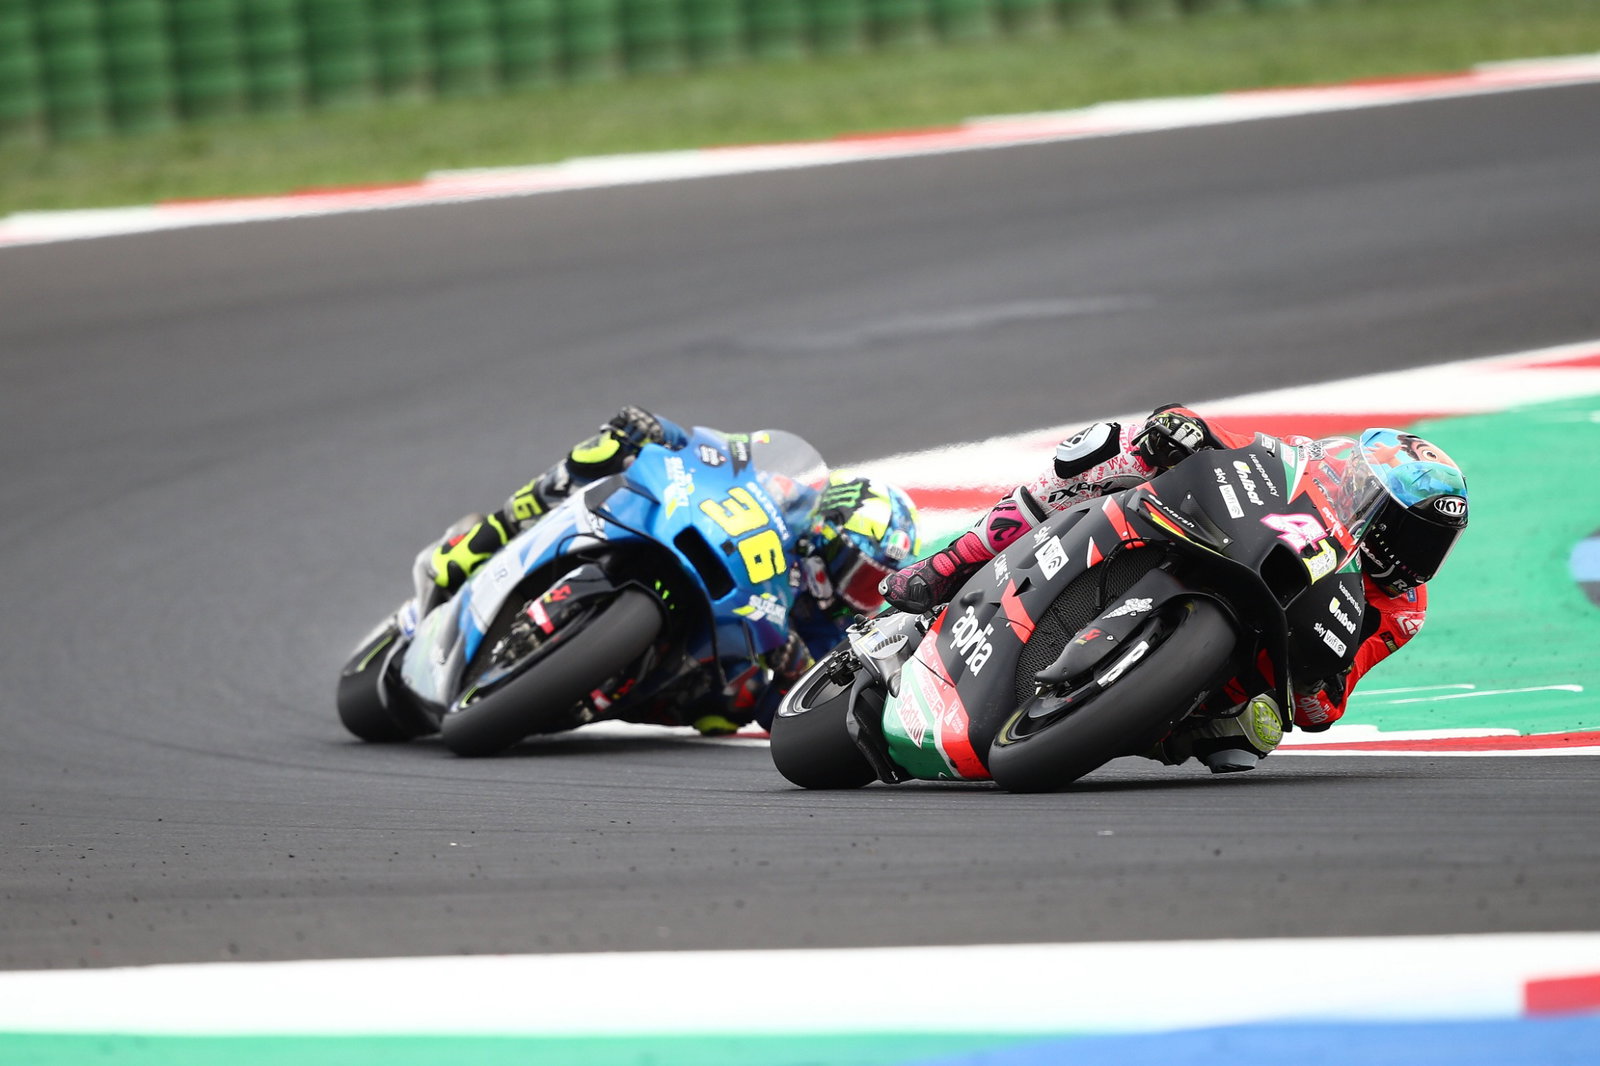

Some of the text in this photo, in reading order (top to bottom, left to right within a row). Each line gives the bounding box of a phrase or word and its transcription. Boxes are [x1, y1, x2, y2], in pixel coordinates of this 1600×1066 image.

[1214, 467, 1228, 485] sky
[1232, 460, 1265, 506] Unibat
[1249, 453, 1279, 497] kaspersky
[746, 481, 790, 541] SUZUKI
[1163, 506, 1195, 528] Marsh
[1322, 506, 1344, 538] aprilia
[1435, 499, 1466, 515] KYT
[700, 487, 787, 584] 36
[1033, 526, 1052, 549] sky
[1259, 513, 1338, 586] 41
[1329, 597, 1357, 635] Unibat
[1338, 580, 1362, 617] kaspersky
[950, 605, 995, 678] aprilia
[1313, 622, 1327, 638] sky
